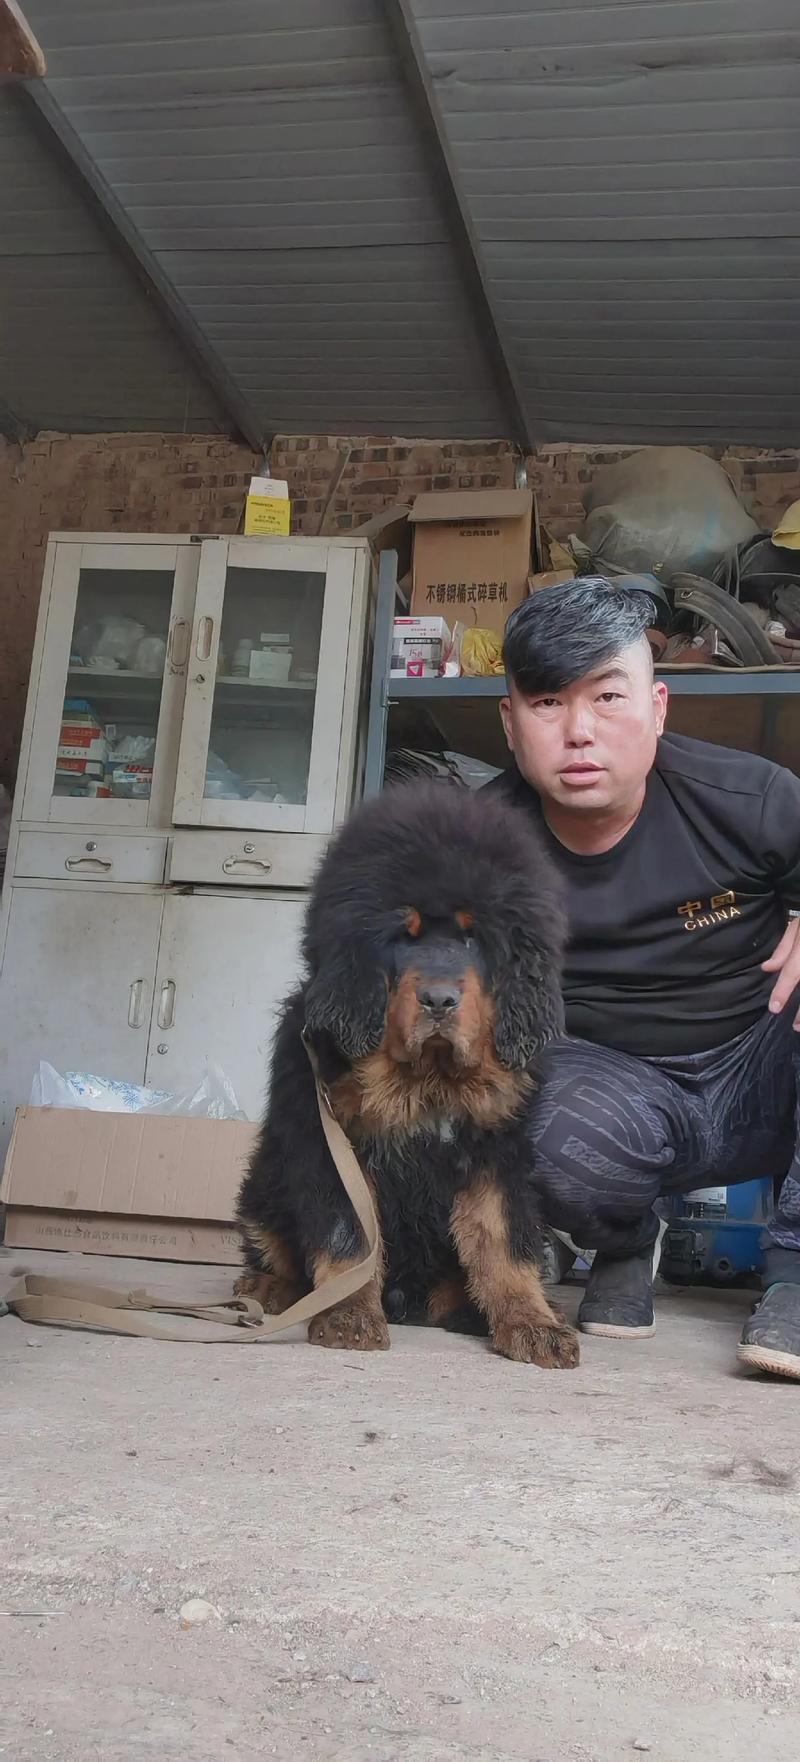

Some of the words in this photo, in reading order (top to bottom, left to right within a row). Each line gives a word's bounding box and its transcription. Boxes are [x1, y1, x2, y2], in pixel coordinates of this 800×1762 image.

[425, 581, 508, 604] 不锈钢桶式碎草机
[677, 890, 736, 918] 中国
[684, 906, 741, 931] CHINA
